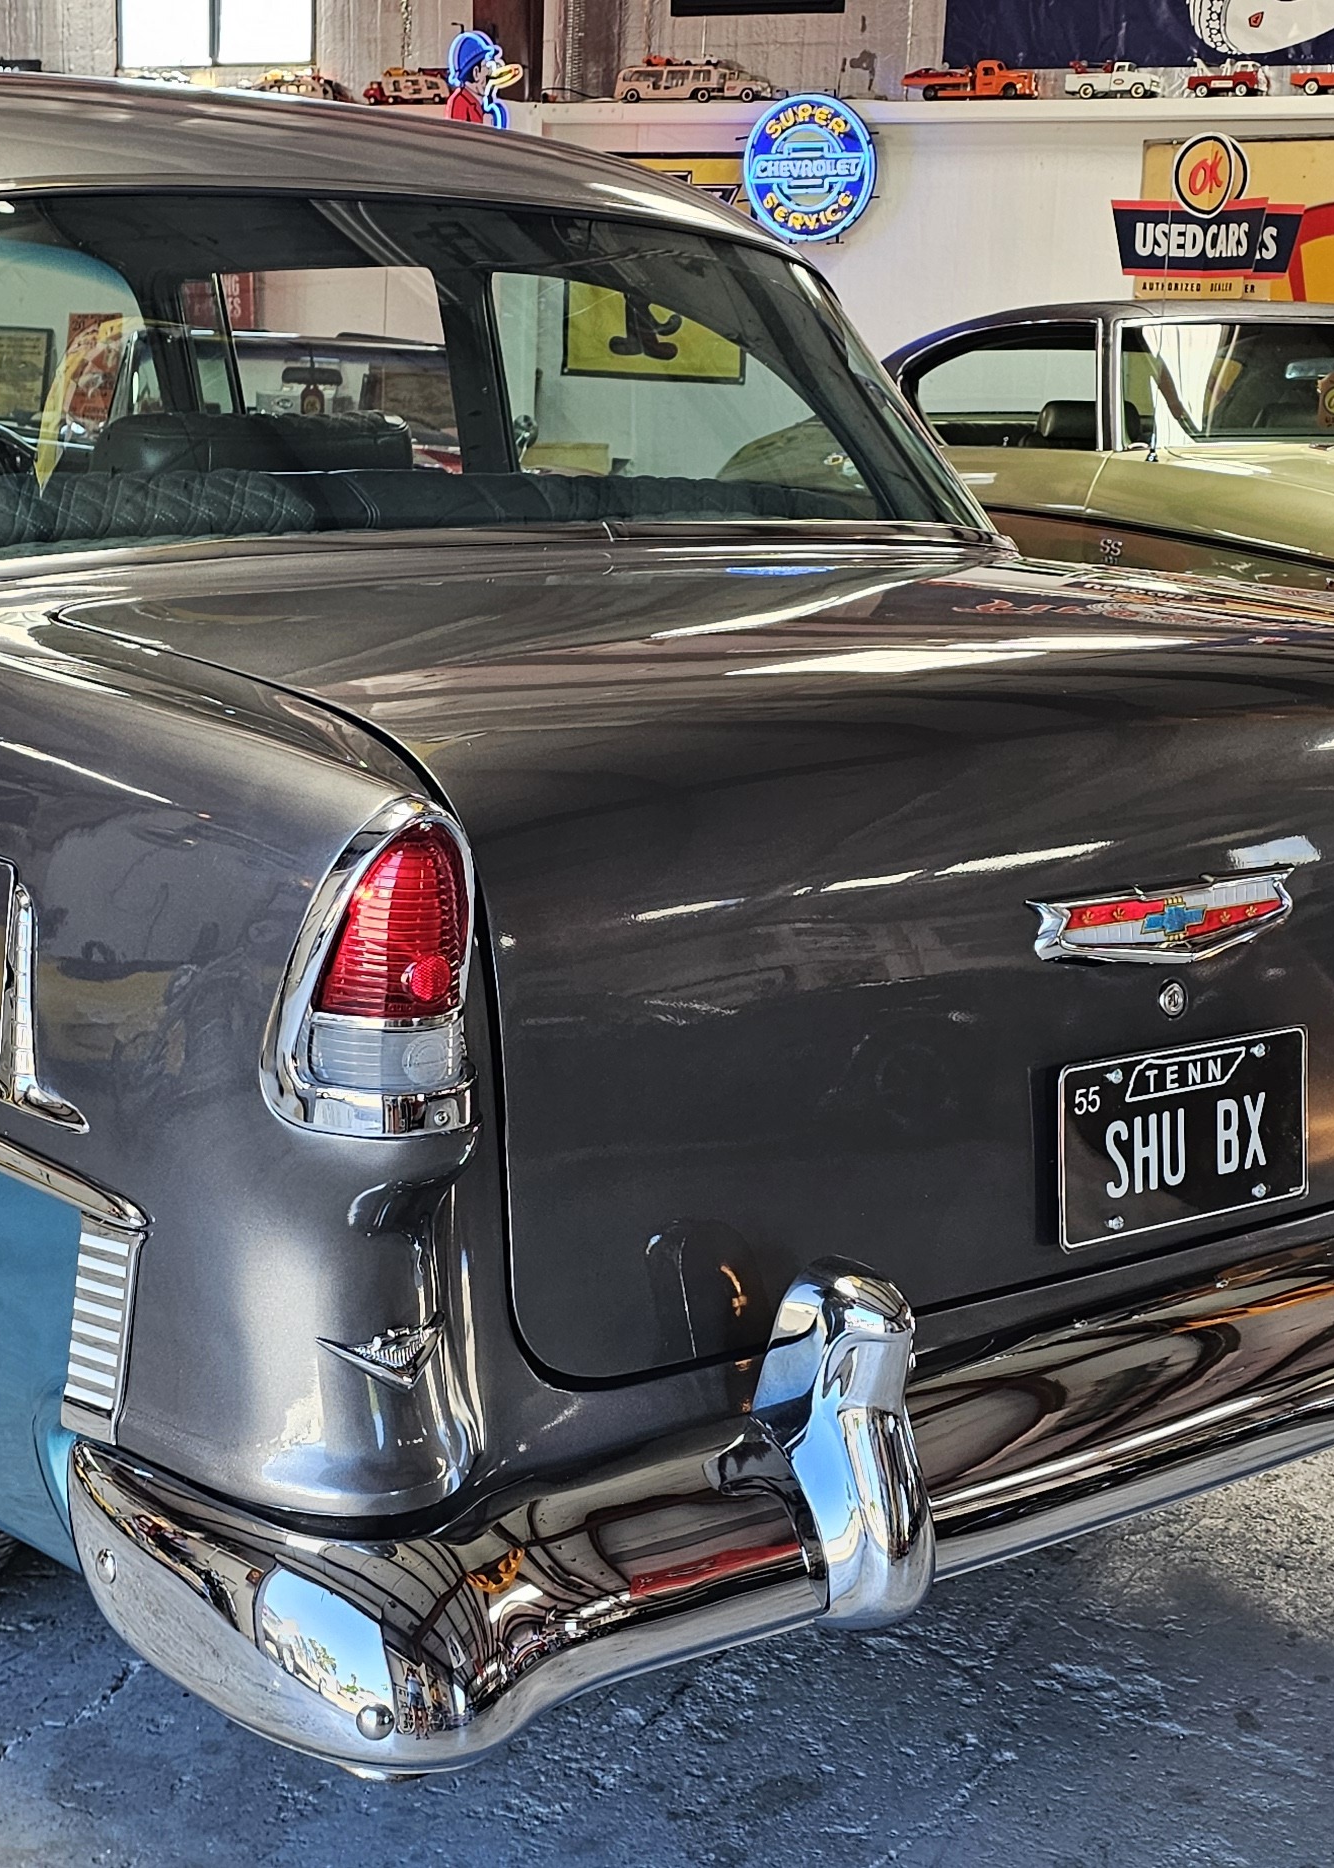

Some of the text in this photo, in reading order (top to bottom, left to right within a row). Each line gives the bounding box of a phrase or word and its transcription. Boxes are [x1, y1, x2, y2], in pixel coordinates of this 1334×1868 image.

[765, 103, 851, 139] SUPER
[755, 159, 860, 177] CHEVROLET
[1188, 151, 1224, 196] OK
[762, 191, 854, 230] SERVICE
[1134, 222, 1204, 258] USED
[1205, 222, 1249, 258] CARS
[1142, 282, 1232, 292] AUTHORIZED DEALER
[1099, 538, 1123, 556] SS
[1145, 1057, 1222, 1094] TENN
[1073, 1085, 1101, 1116] 55
[1105, 1091, 1267, 1200] SHU BX
